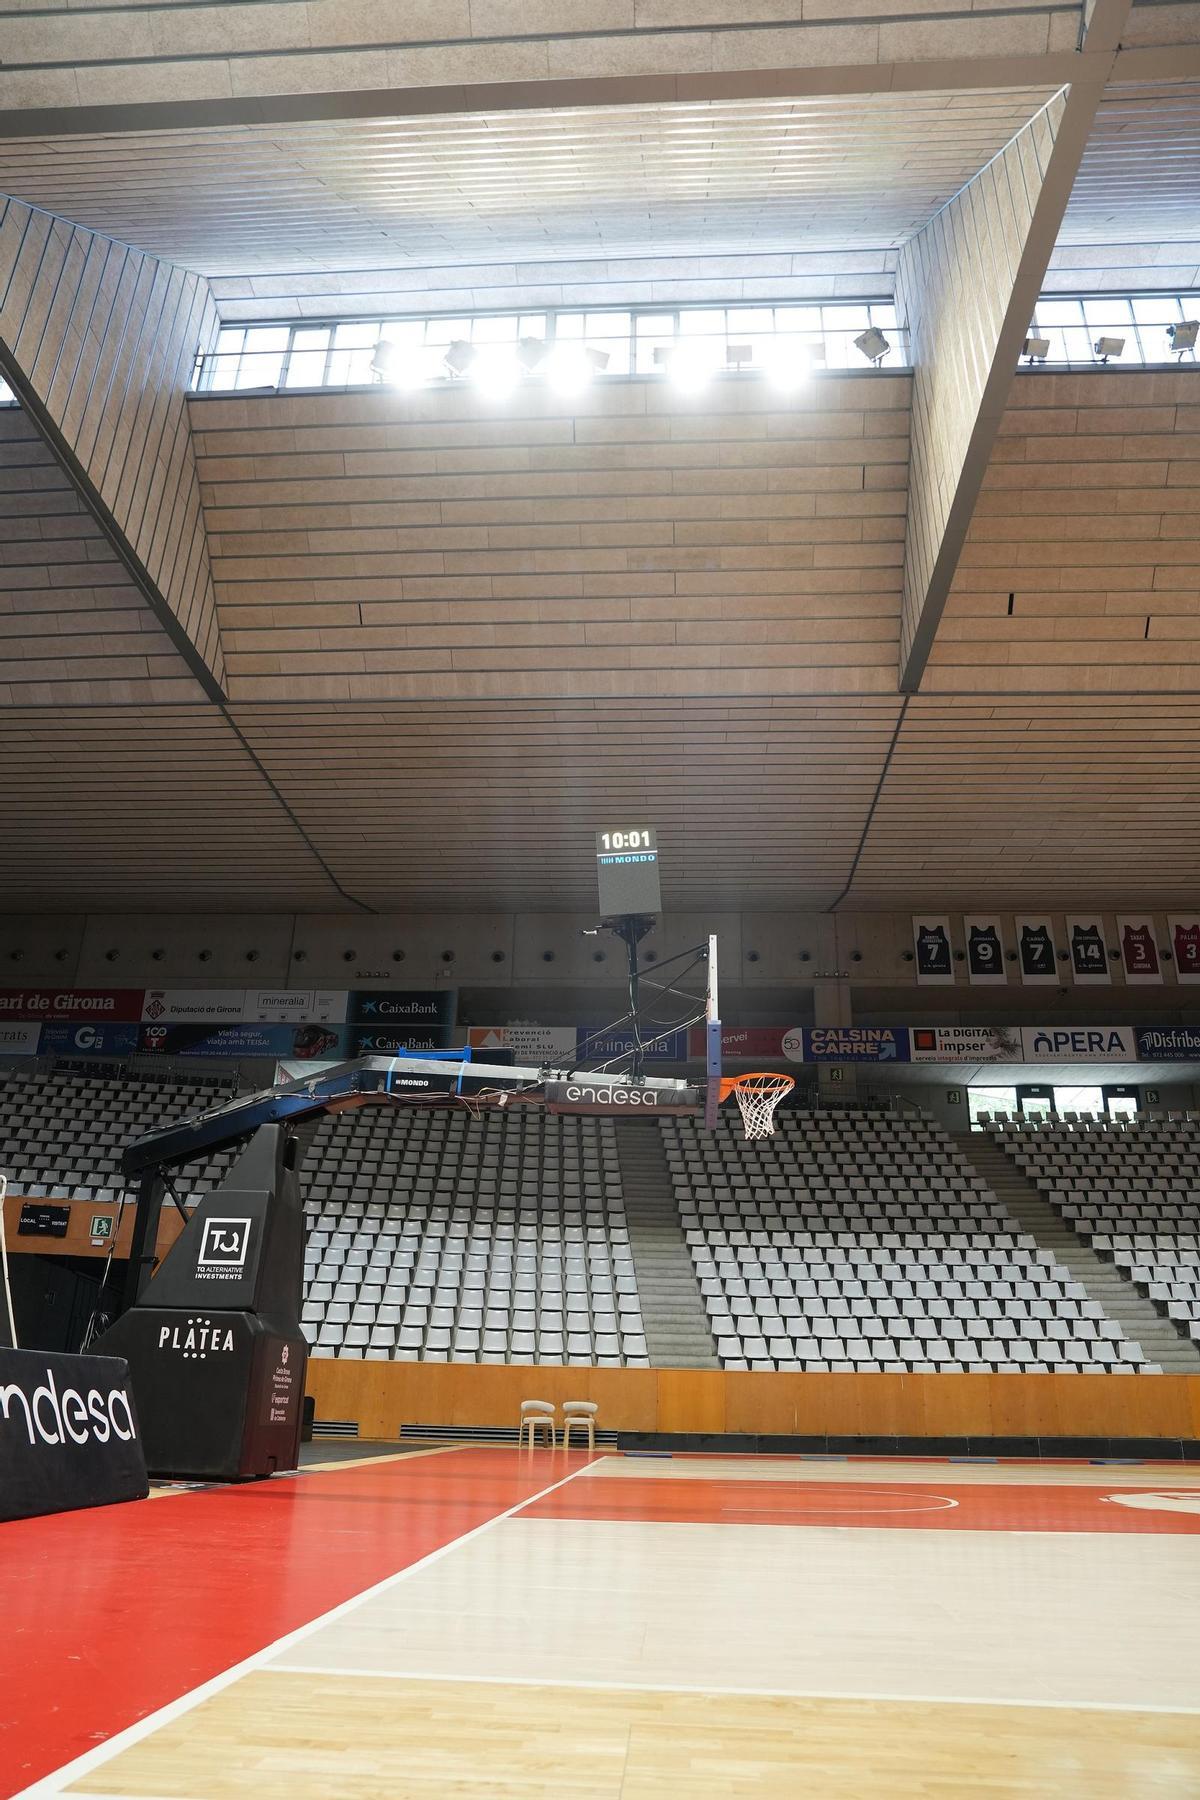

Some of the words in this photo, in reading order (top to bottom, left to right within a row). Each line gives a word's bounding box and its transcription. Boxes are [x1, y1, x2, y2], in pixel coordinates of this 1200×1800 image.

[602, 831, 650, 849] 10:01
[615, 855, 656, 864] MONDO
[927, 944, 939, 960] 7
[977, 943, 993, 960] 9
[1030, 944, 1044, 960] 7
[1077, 944, 1101, 960] 14
[1133, 943, 1146, 960] 3
[1186, 943, 1197, 959] 3
[27, 994, 50, 1010] de
[53, 994, 116, 1011] Girona
[262, 997, 305, 1006] mineralia
[379, 1001, 439, 1014] CaixaBank
[170, 1006, 205, 1014] Diputació
[206, 1005, 216, 1013] de
[217, 1006, 242, 1014] Girona
[0, 1031, 29, 1041] rats
[217, 1030, 238, 1038] Viatja
[240, 1031, 264, 1039] segur,
[720, 1032, 748, 1045] ervei
[811, 1029, 895, 1041] CALSINA
[938, 1029, 950, 1037] La
[954, 1029, 995, 1037] DIGITAL
[207, 1038, 227, 1046] viatja
[375, 1037, 436, 1049] CaixaBank
[939, 1040, 985, 1055] impser
[400, 1079, 429, 1087] MONDO
[566, 1085, 659, 1105] endesa
[210, 1230, 241, 1253] TQ
[206, 1266, 244, 1274] ALTERNATIVE
[158, 1326, 235, 1352] PLATEA
